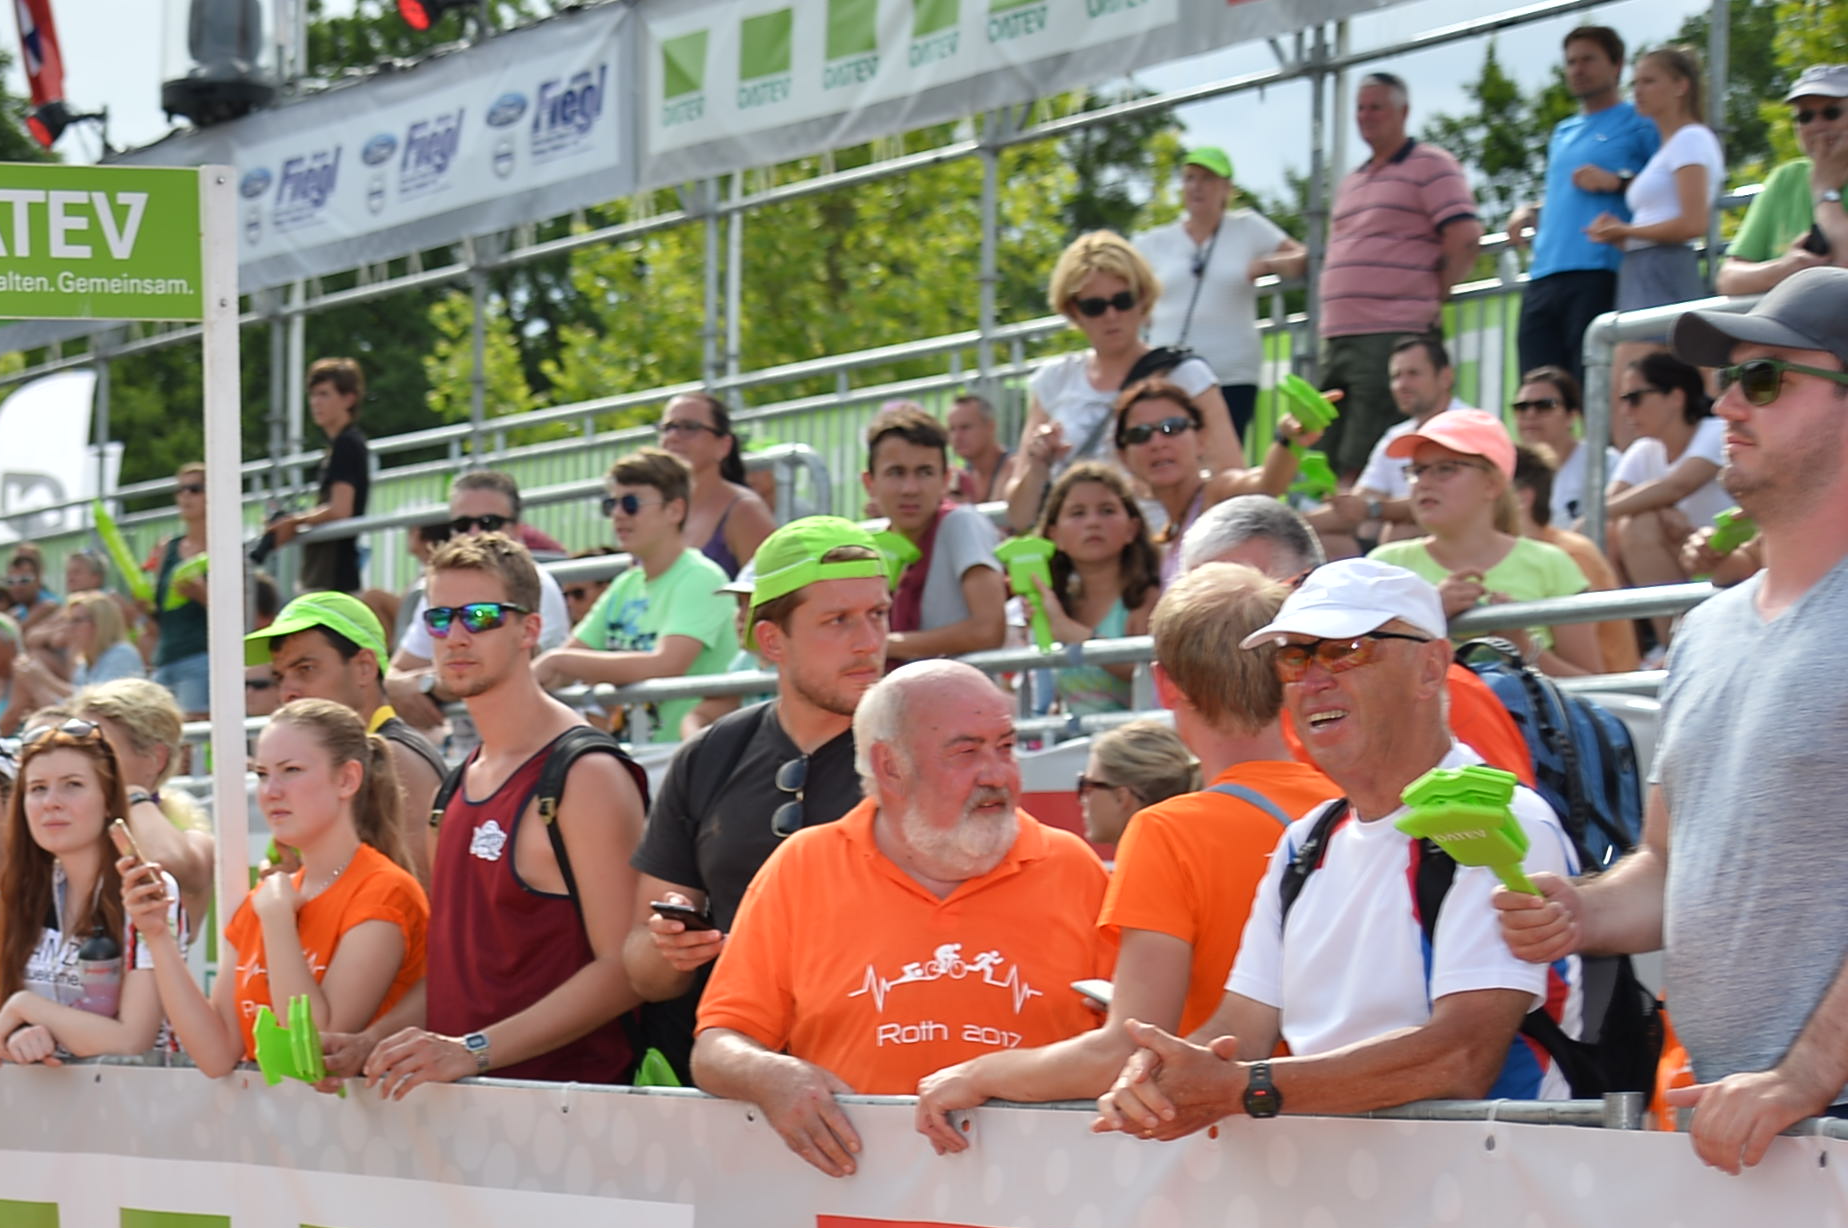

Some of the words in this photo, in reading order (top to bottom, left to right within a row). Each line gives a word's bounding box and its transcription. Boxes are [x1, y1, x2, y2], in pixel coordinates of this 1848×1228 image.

[57, 271, 194, 296] Gemeinsam.
[877, 1020, 949, 1047] Roth
[961, 1024, 1022, 1048] 2017
